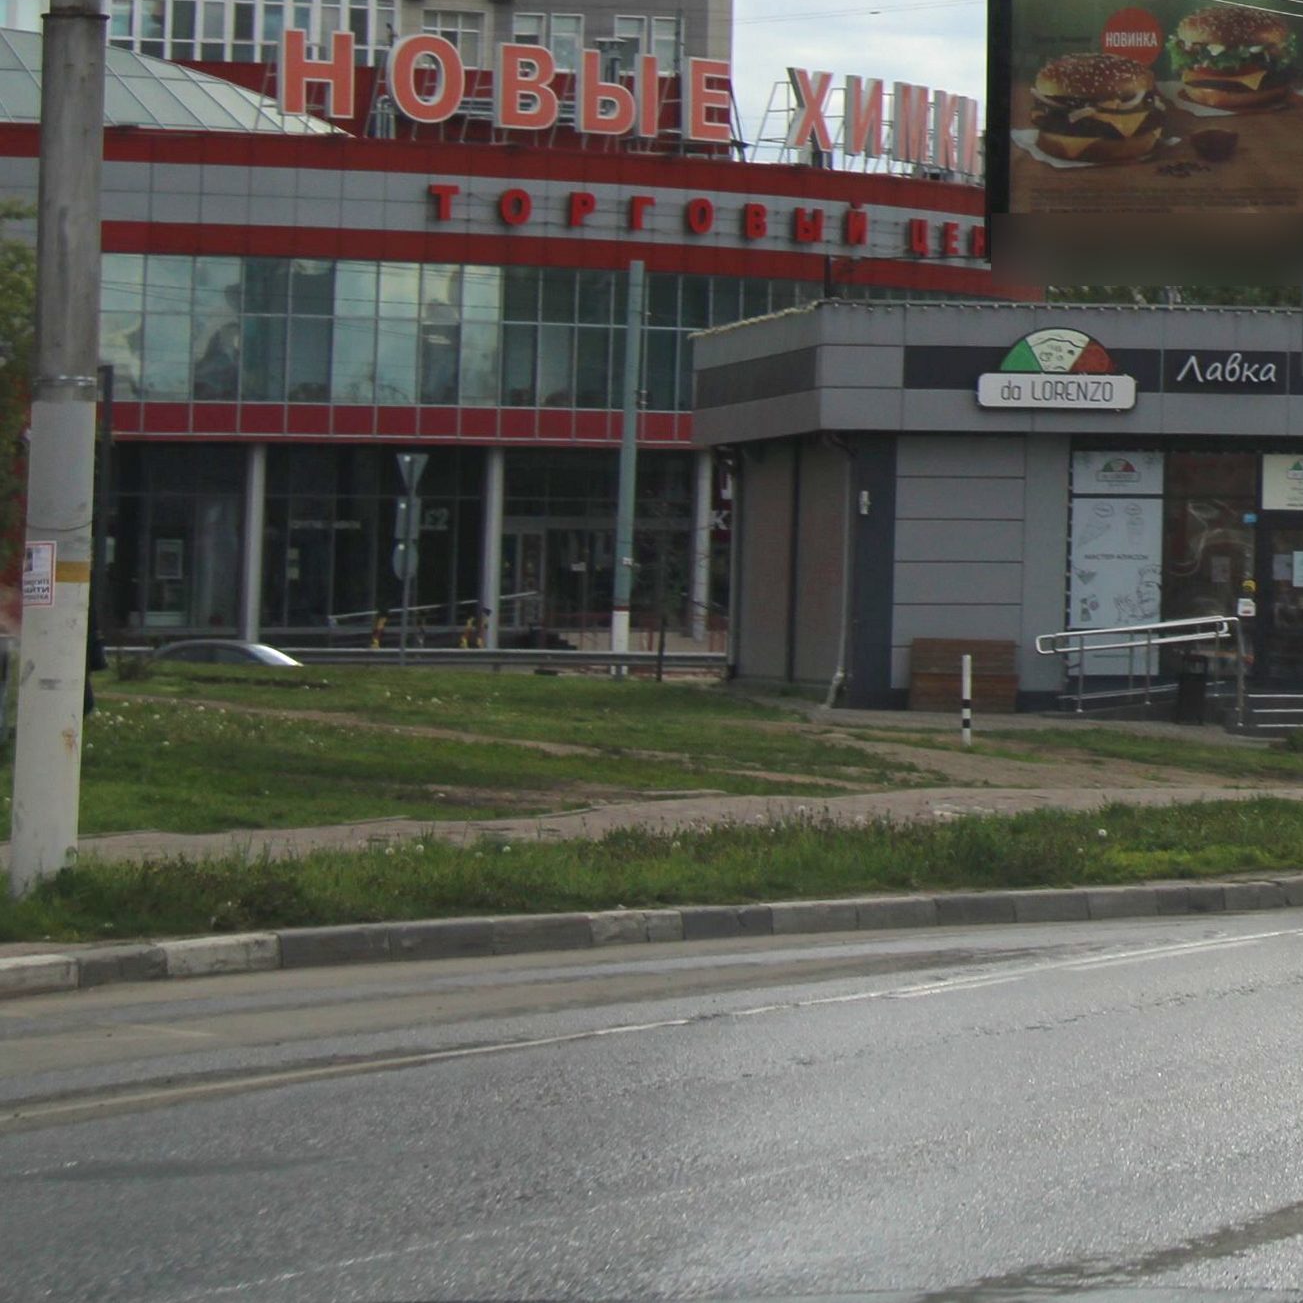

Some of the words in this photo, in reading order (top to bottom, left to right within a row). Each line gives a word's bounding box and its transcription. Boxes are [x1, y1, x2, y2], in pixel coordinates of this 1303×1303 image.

[1105, 32, 1158, 47] НОВИНКА
[279, 29, 731, 142] НОВЫЕ
[787, 67, 978, 177] ХИМКИ
[428, 184, 868, 245] ТОРГОВЫЙ
[1176, 352, 1277, 383] Лавка
[1000, 381, 1022, 401] da
[1031, 381, 1114, 403] LORENZO
